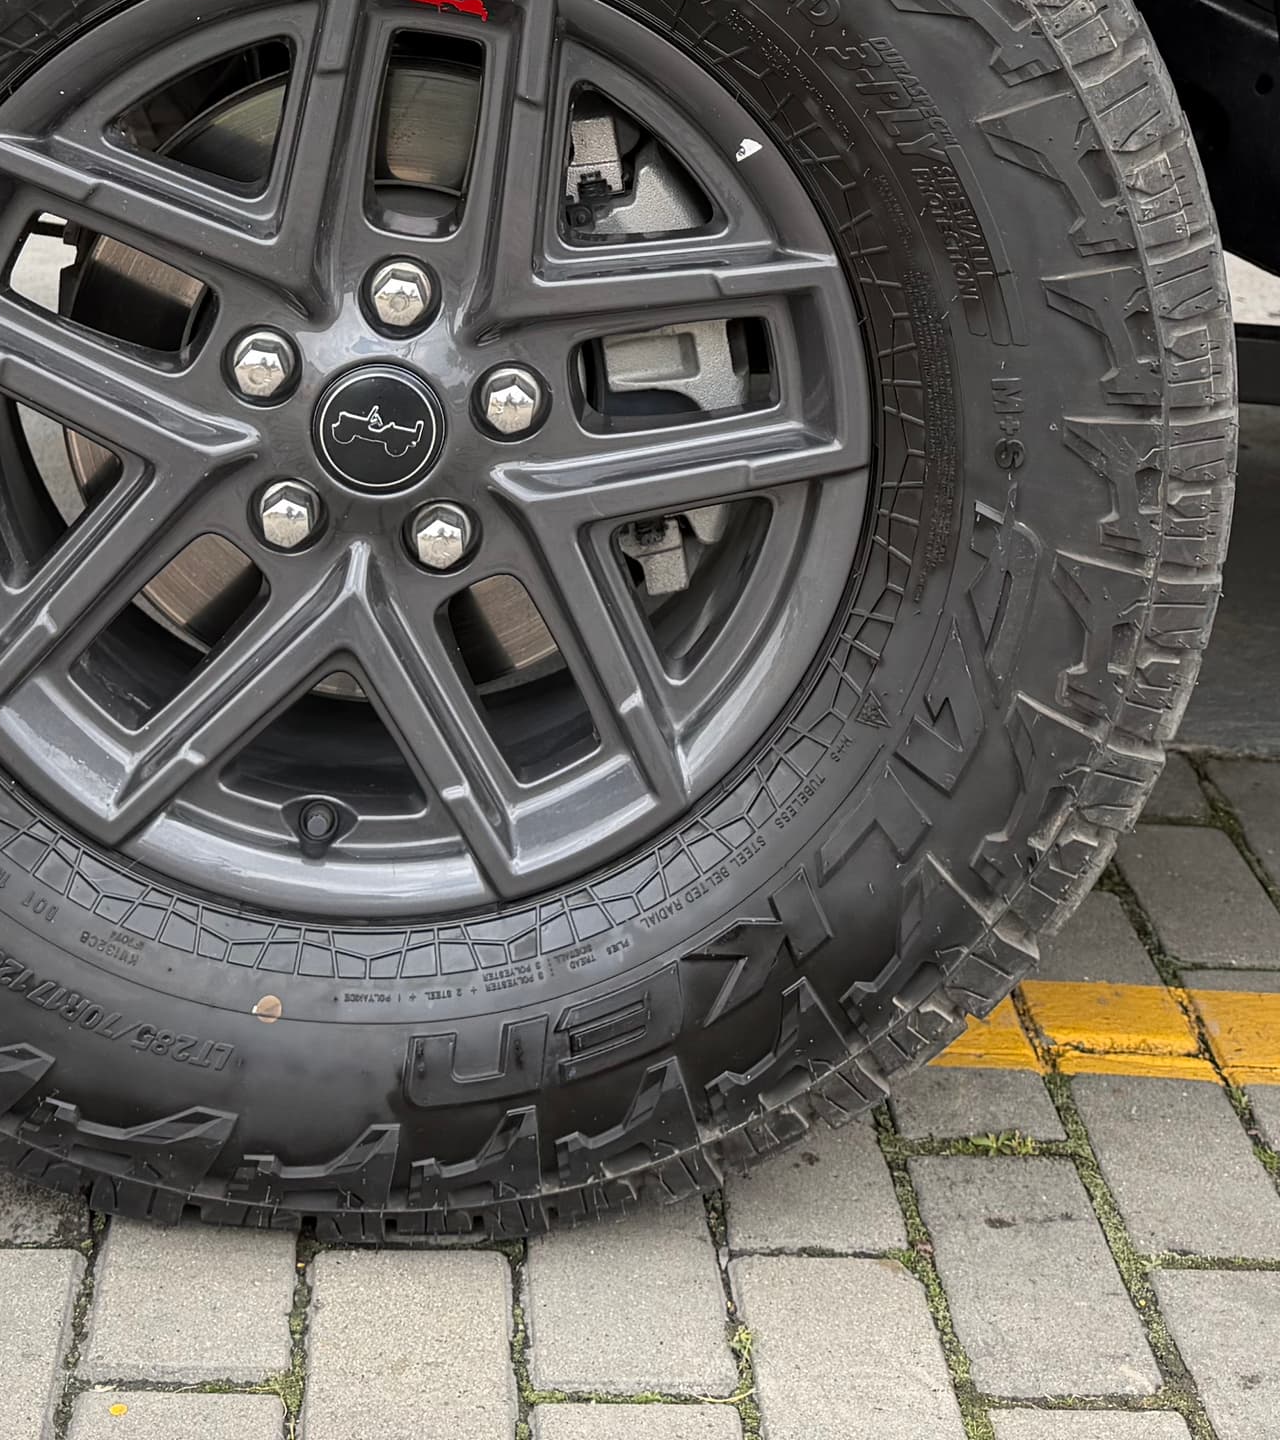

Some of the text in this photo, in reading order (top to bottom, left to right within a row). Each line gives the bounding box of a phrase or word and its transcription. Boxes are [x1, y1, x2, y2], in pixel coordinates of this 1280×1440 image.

[989, 374, 1025, 472] M+S
[770, 769, 828, 832] TUBELESS
[726, 832, 769, 872] STEEL
[680, 864, 732, 906] BELTED
[637, 896, 686, 932] RADIAL
[482, 971, 536, 996] POLYESTER
[23, 976, 237, 1073] LT285/70R17
